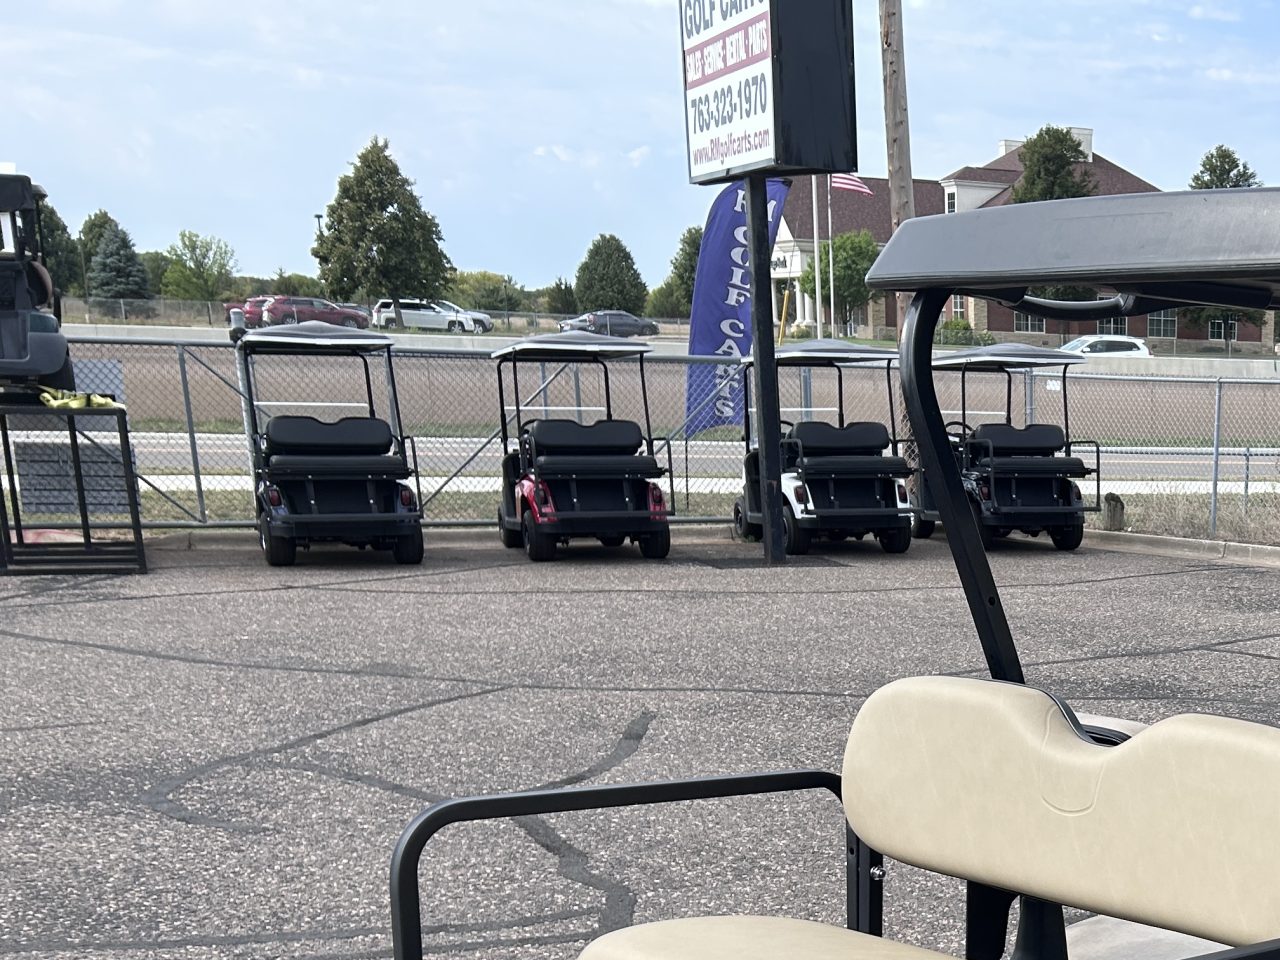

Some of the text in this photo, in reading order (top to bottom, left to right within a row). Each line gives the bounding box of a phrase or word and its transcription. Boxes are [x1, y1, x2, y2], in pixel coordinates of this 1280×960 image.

[685, 0, 715, 39] GOLF
[748, 19, 768, 58] PARTS
[691, 72, 767, 134] 763-323-1970
[692, 128, 770, 166] www.RMgolfcarts.com
